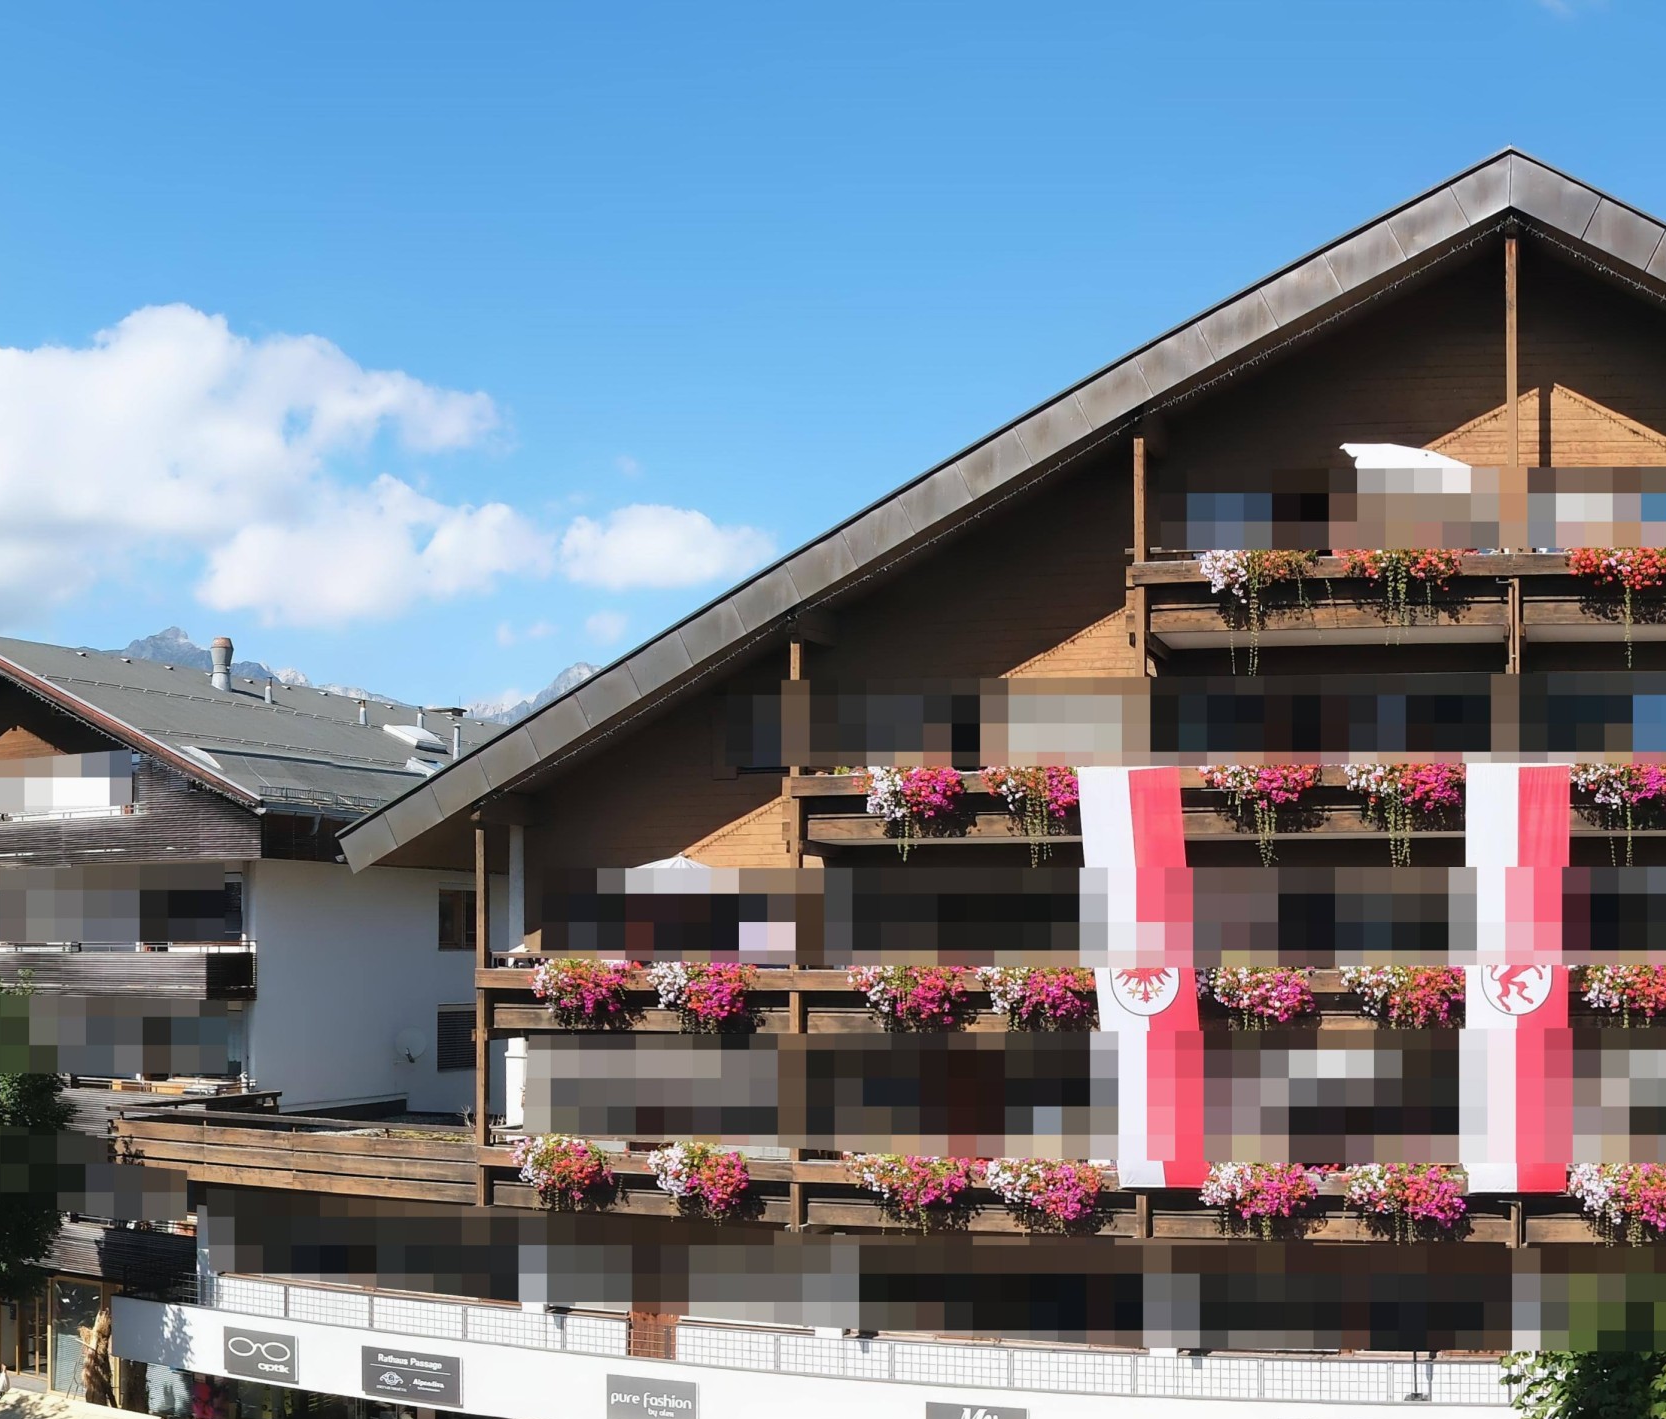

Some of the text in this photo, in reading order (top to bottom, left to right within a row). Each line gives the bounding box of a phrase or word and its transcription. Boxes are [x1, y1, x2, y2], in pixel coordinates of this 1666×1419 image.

[257, 1362, 290, 1374] optik
[377, 1353, 443, 1370] Rathaus Passage
[610, 1391, 693, 1410] pure fashion
